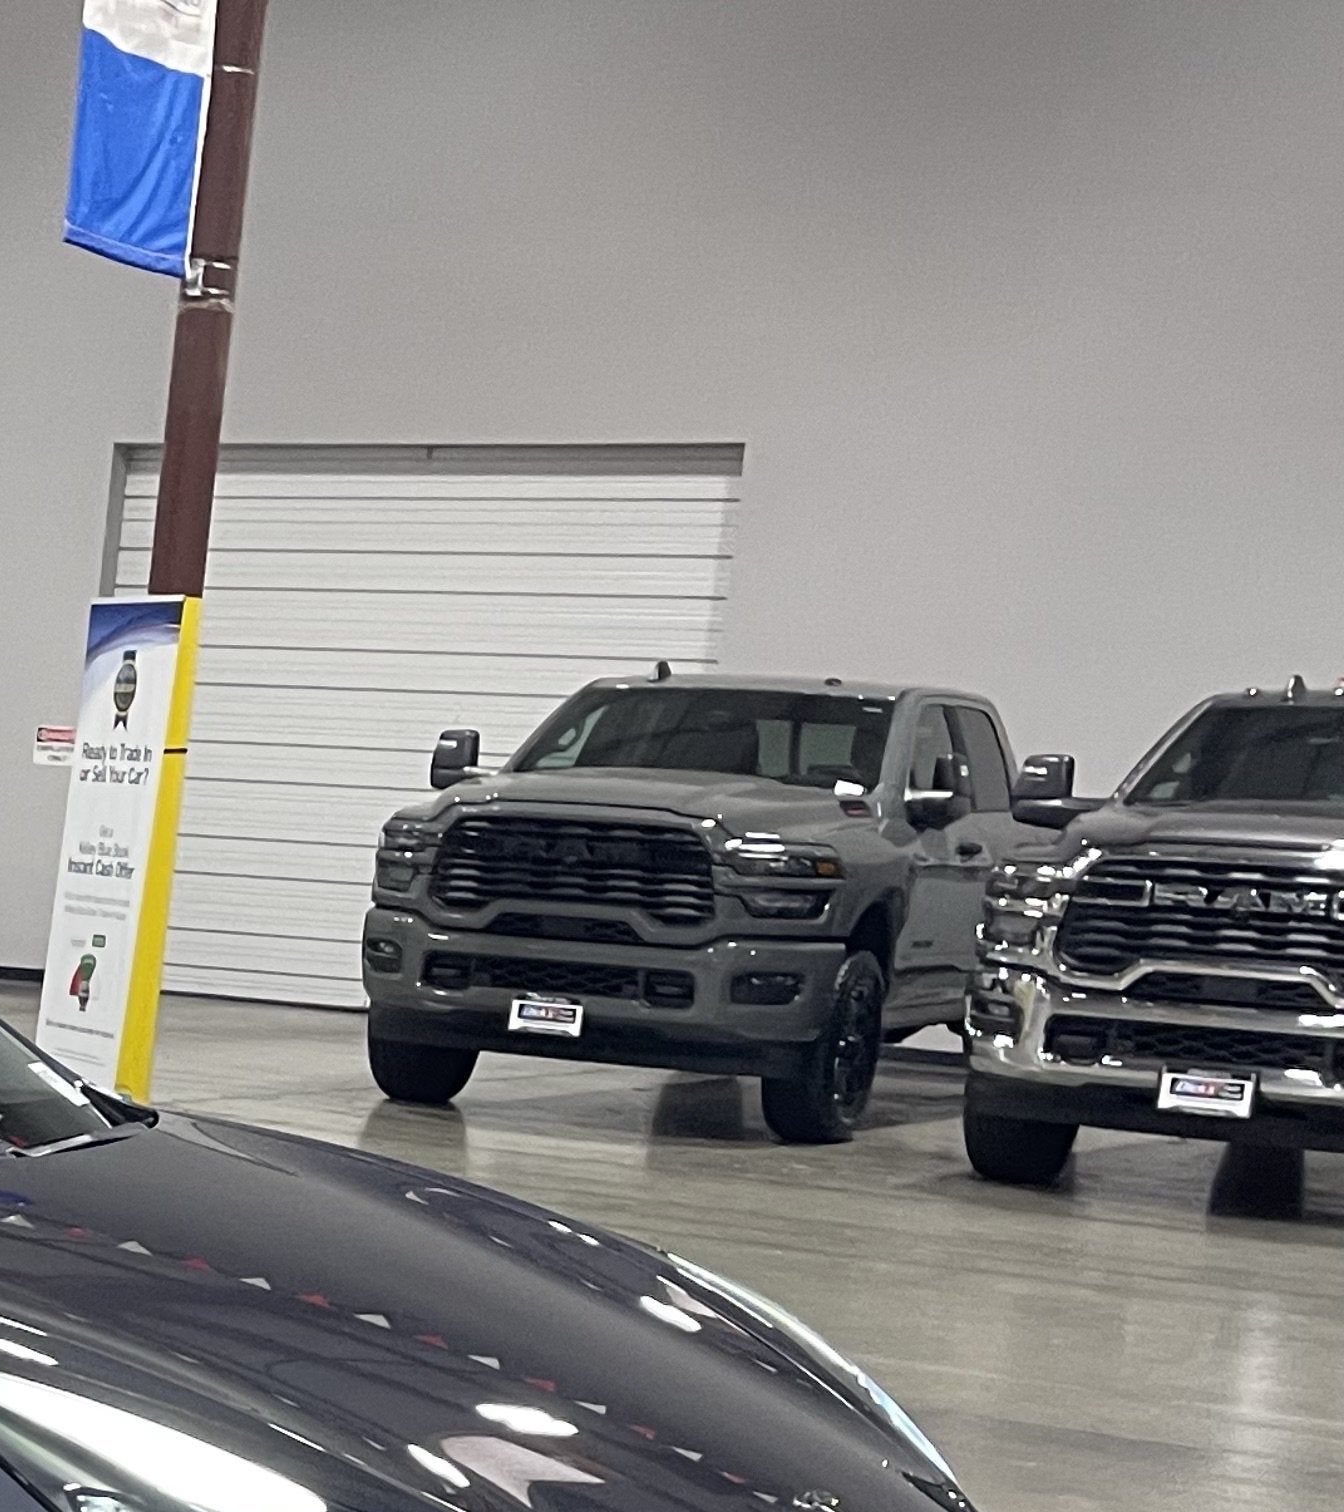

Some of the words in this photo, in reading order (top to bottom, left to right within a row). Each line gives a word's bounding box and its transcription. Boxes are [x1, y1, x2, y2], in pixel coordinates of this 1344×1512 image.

[82, 742, 106, 766] Ready
[109, 745, 118, 760] to
[120, 743, 142, 761] Trade
[143, 744, 153, 762] In
[79, 768, 91, 782] or
[92, 764, 107, 783] Sell
[109, 765, 127, 783] Your
[128, 767, 149, 785] Car?
[1153, 882, 1328, 917] RAM
